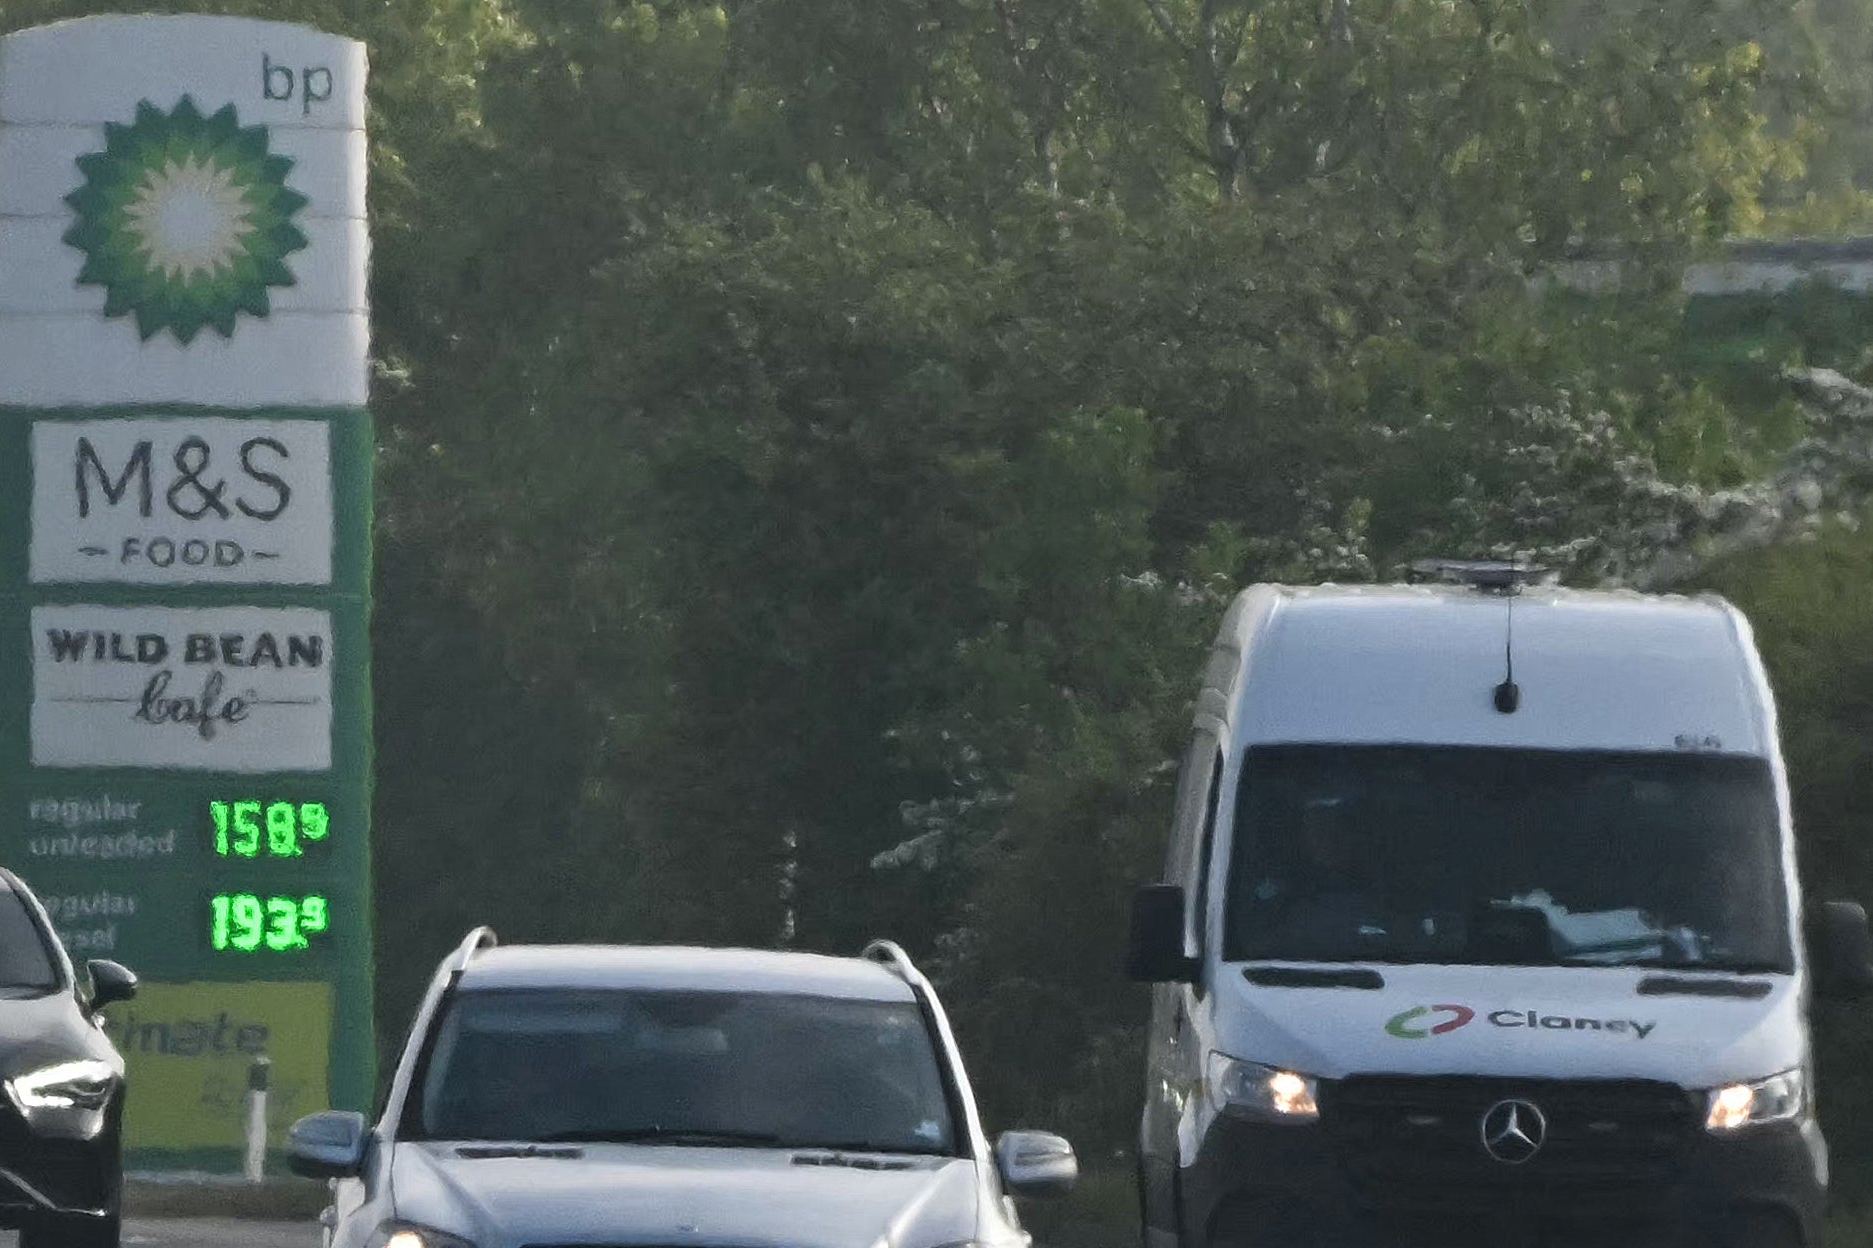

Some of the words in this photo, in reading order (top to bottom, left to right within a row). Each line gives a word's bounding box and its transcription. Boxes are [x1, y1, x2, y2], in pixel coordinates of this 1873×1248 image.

[262, 51, 333, 115] bp
[75, 435, 292, 521] M&S
[120, 535, 245, 568] FOOD
[46, 629, 168, 665] WILD
[184, 632, 323, 669] BEAN
[30, 794, 142, 827] regular
[30, 829, 175, 858] unleaded
[42, 889, 135, 921] egular
